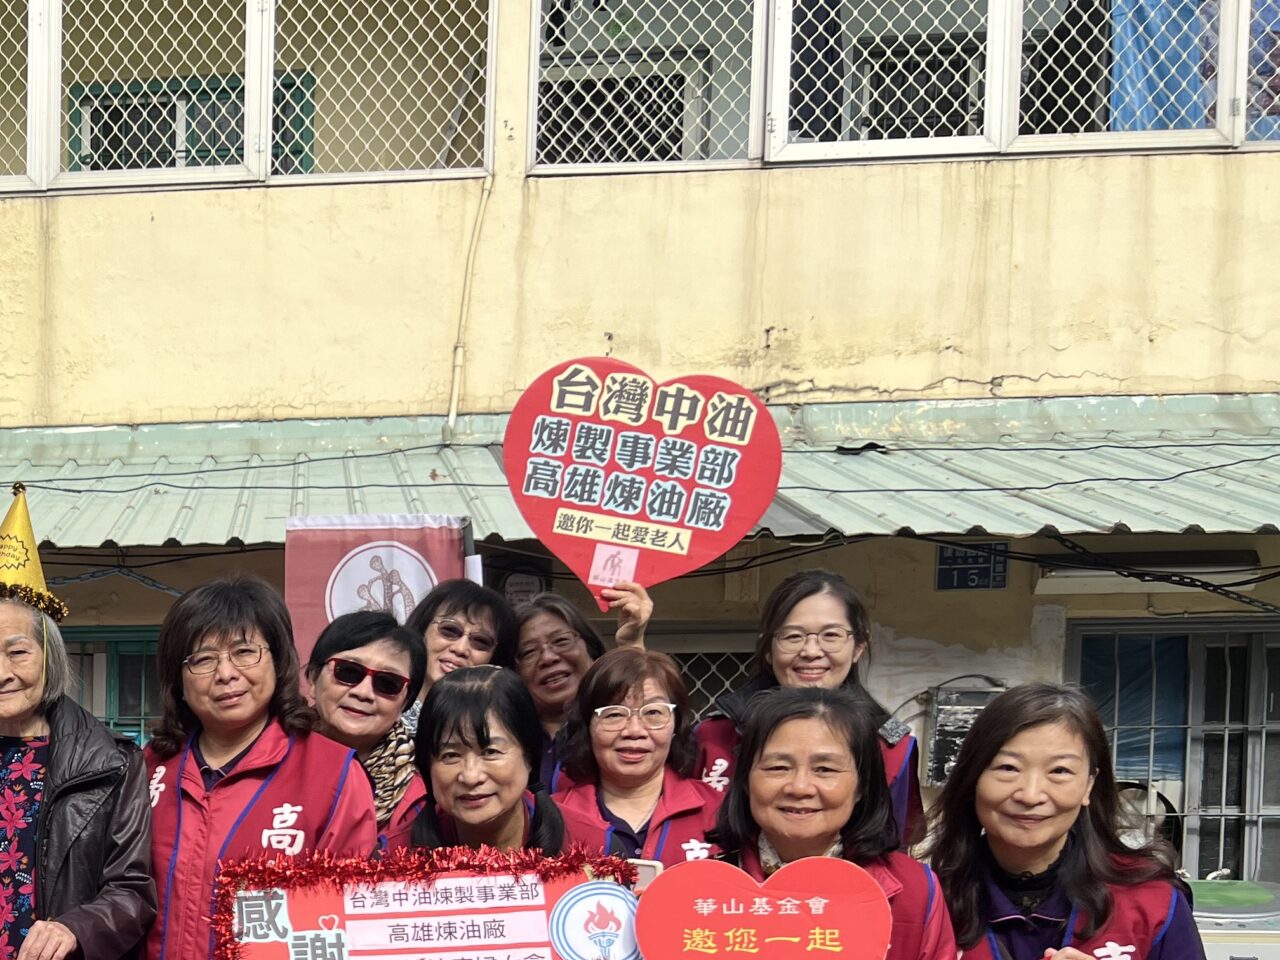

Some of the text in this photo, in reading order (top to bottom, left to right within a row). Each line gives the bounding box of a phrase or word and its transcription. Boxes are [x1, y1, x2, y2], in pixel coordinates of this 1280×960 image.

[553, 366, 755, 443] 台灣中油
[529, 416, 740, 487] 煉製事業部
[522, 458, 728, 530] 高雄煉油廠
[556, 512, 687, 552] 邀你一起愛老人
[951, 569, 979, 587] 15
[349, 882, 540, 910] 台灣中油煉製事業部
[692, 895, 830, 917] 華山基金會
[388, 919, 508, 944] 高雄煉油廠
[681, 925, 845, 954] 邀您一起
